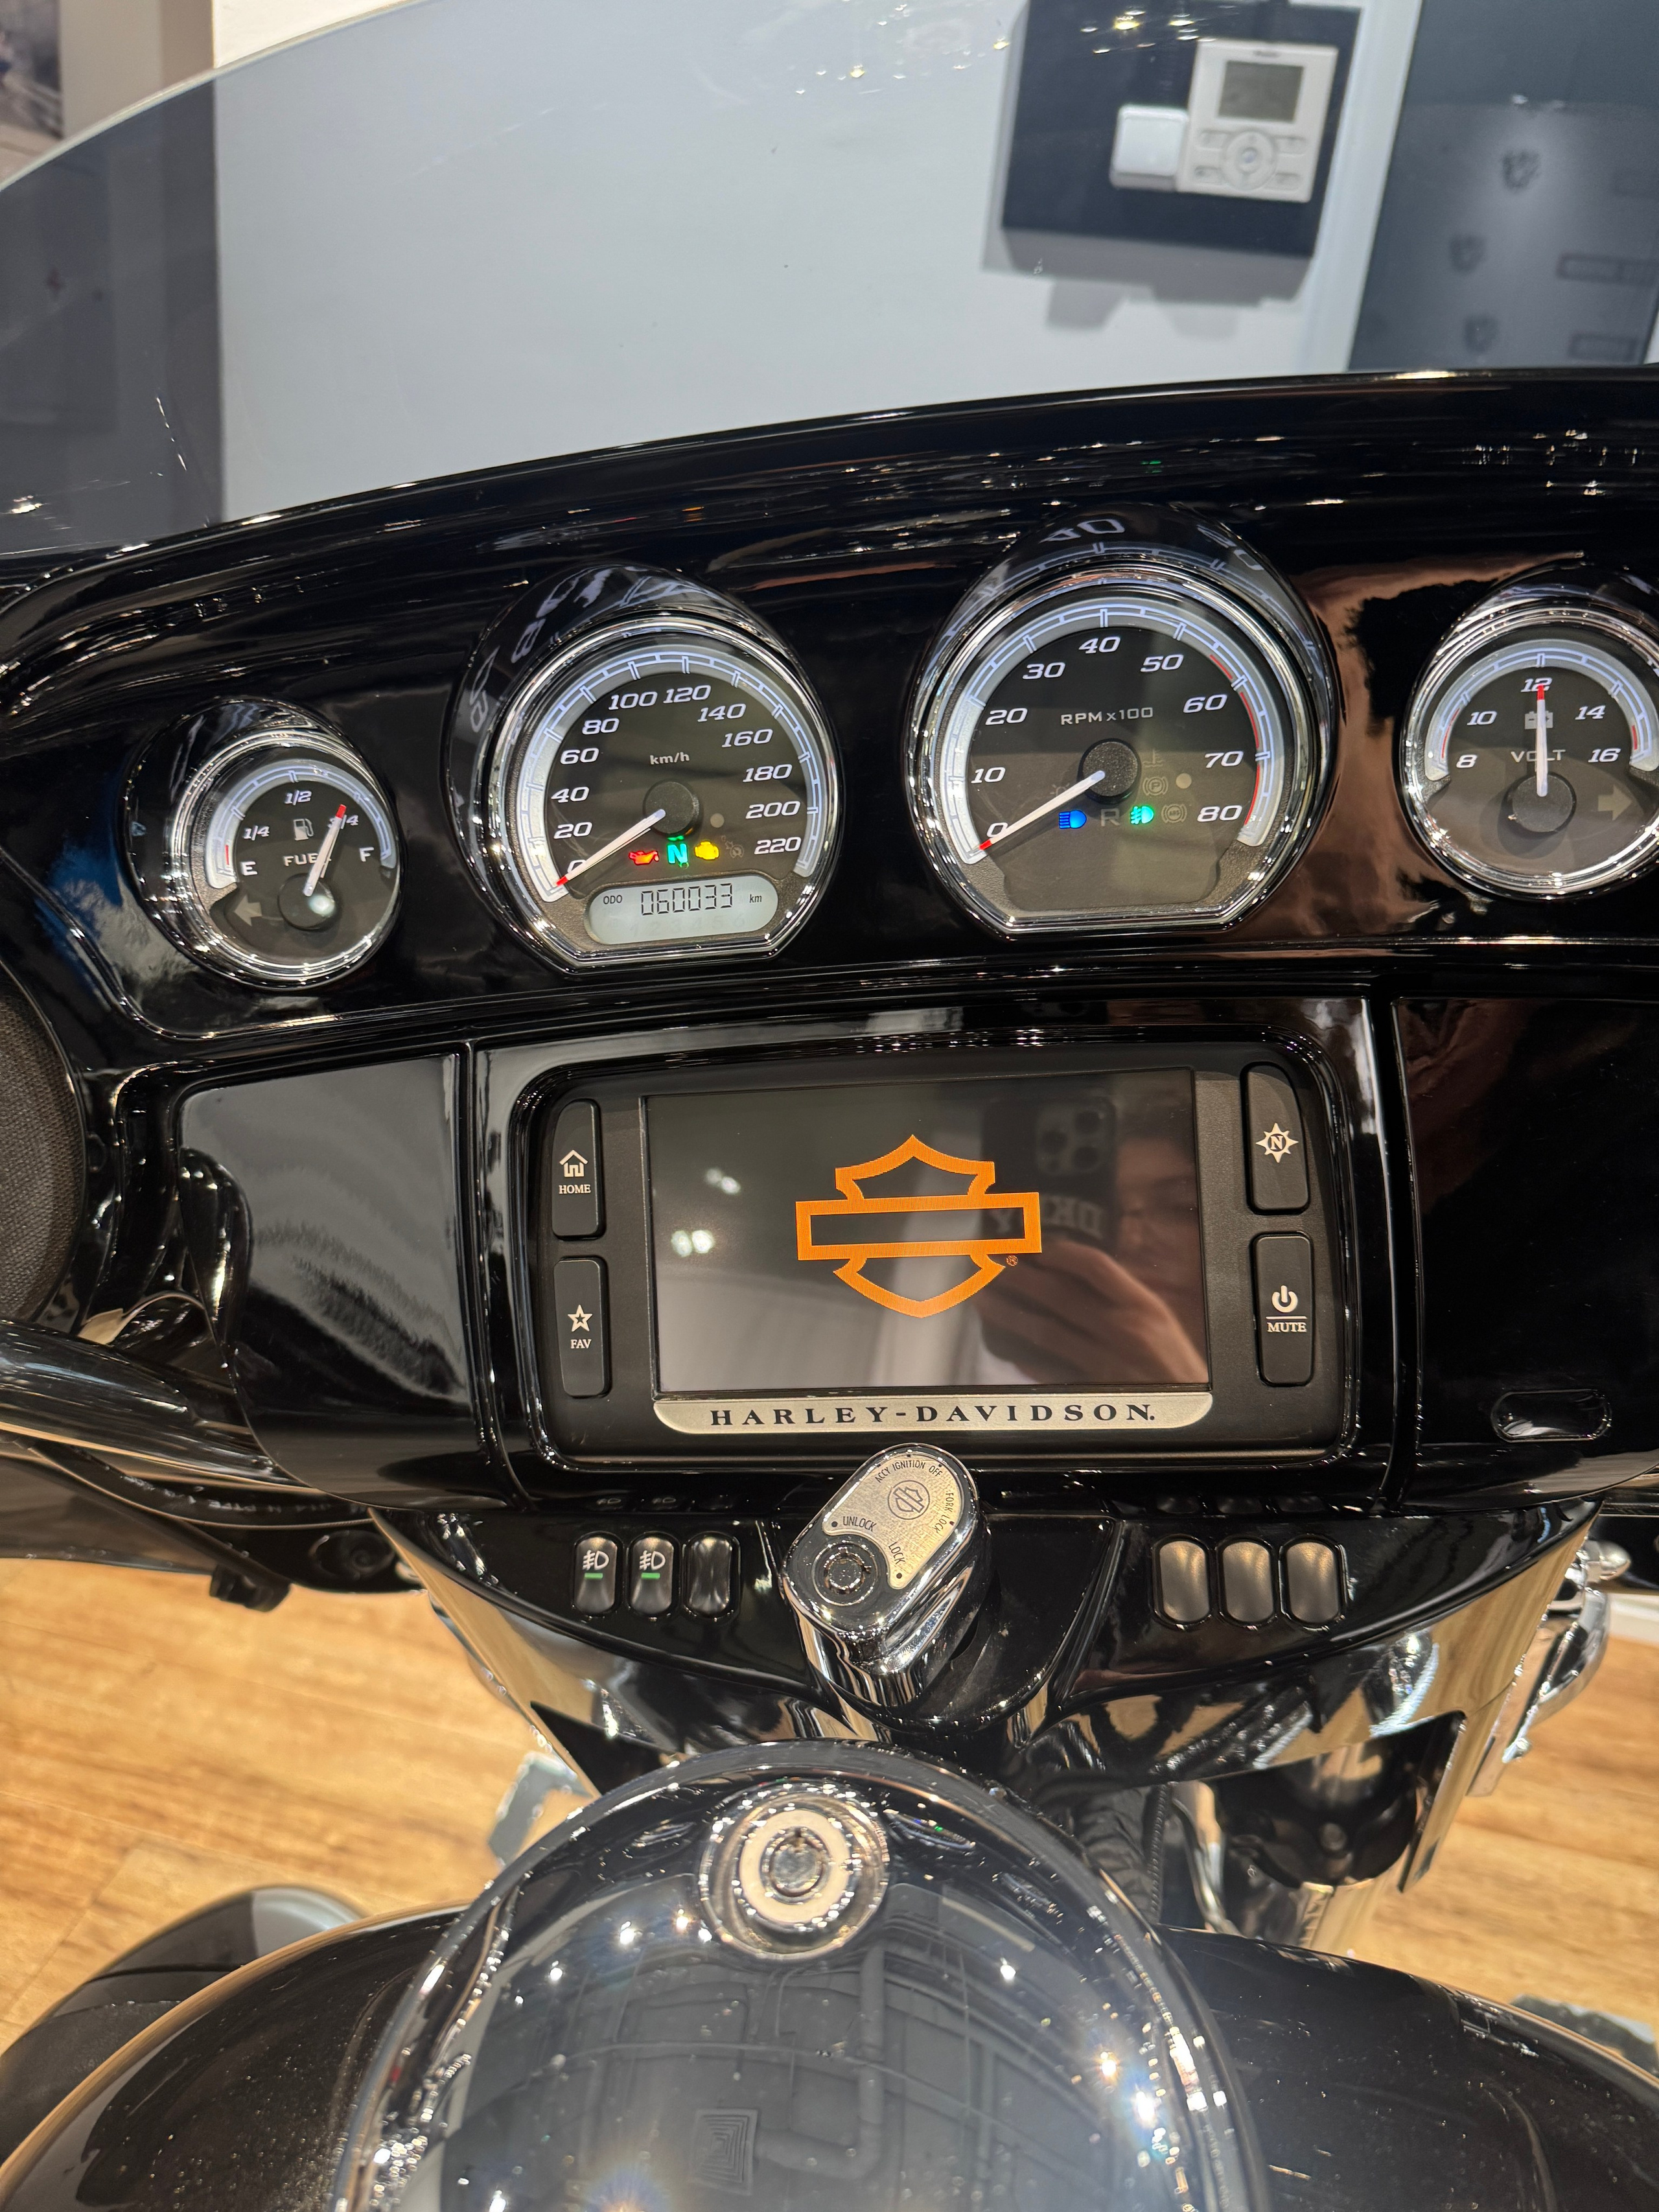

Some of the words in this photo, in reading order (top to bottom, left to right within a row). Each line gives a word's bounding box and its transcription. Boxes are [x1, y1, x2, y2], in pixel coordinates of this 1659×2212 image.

[1078, 636, 1121, 654] 40
[1022, 662, 1066, 680] 30
[1140, 654, 1185, 673] 50
[1520, 677, 1553, 692] 12
[608, 691, 658, 711] 100
[662, 684, 712, 704] 120
[697, 703, 747, 723] 140
[1183, 694, 1228, 714] 60
[1575, 704, 1606, 720] 14
[984, 707, 1028, 726] 20
[1060, 711, 1102, 725] RPM
[1106, 707, 1154, 721] x100
[1467, 710, 1498, 727] 10
[582, 717, 620, 736] 80
[722, 728, 773, 748] 160
[560, 747, 599, 765] 60
[649, 752, 690, 766] km/h
[1204, 751, 1244, 769] 70
[1456, 754, 1478, 769] 8
[1588, 748, 1621, 763] 16
[743, 763, 793, 783] 180
[971, 766, 1006, 785] 10
[284, 790, 312, 806] 1/2
[550, 786, 590, 804] 40
[745, 801, 801, 820] 200
[1100, 808, 1121, 827] R
[1196, 805, 1242, 822] 80
[242, 824, 270, 841] 1/4
[553, 821, 592, 840] 20
[986, 822, 1008, 837] 0
[359, 846, 375, 862] F
[667, 843, 689, 865] N
[754, 836, 802, 856] 220
[242, 861, 258, 876] E
[283, 852, 332, 867] FUE
[603, 894, 623, 905] ODO
[640, 882, 733, 916] 060033
[749, 894, 763, 904] km
[559, 1184, 592, 1194] HOME
[1266, 1321, 1307, 1333] MUTE
[570, 1338, 592, 1349] FAV
[875, 1467, 890, 1483] ACCY
[892, 1460, 926, 1471] IGNITION
[929, 1465, 943, 1476] OFF
[944, 1493, 954, 1512] FORK
[843, 1517, 877, 1532] UNLOCK
[932, 1515, 950, 1533] LOCK
[888, 1542, 906, 1565] LOCK
